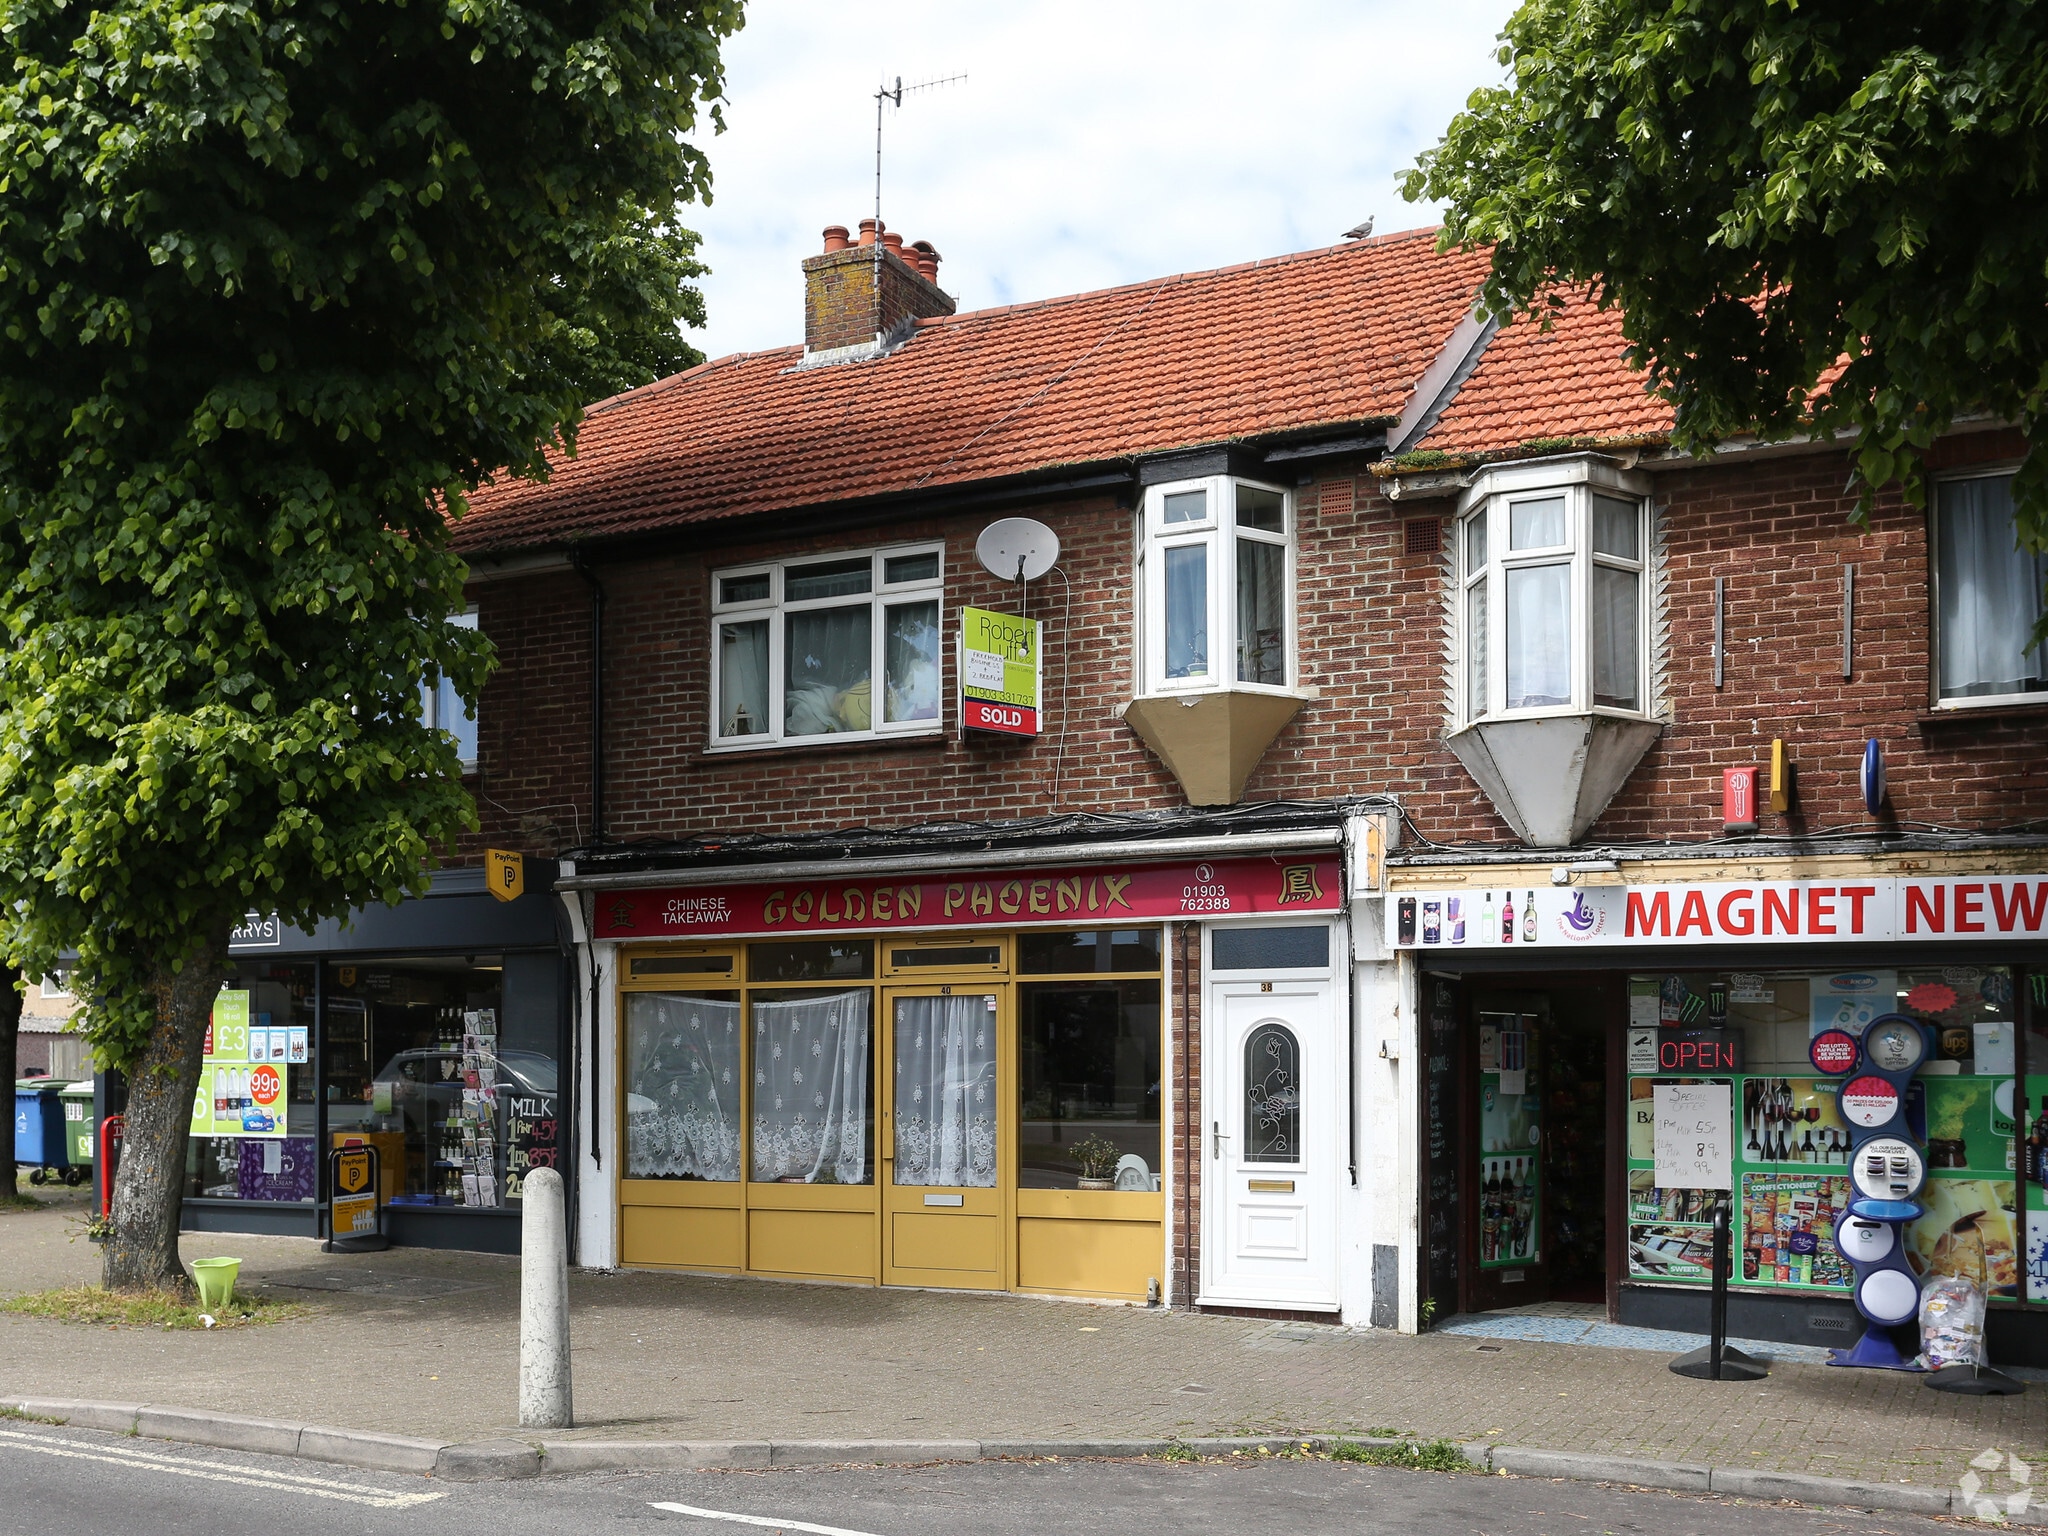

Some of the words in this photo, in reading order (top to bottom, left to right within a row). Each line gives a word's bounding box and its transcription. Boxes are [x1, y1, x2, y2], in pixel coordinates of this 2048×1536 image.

[980, 617, 1034, 646] Robert
[1000, 690, 1034, 706] 331737
[980, 705, 1022, 727] SOLD
[494, 852, 521, 863] PayPoint
[1183, 884, 1226, 898] 01903
[667, 897, 726, 911] CHINESE
[763, 884, 922, 926] GOLDEN
[943, 874, 1134, 918] PHOENIX
[1180, 898, 1230, 911] 762388
[609, 897, 636, 931] 金
[662, 910, 732, 925] TAKEAWAY
[1625, 886, 1875, 938] MAGNET
[1906, 882, 2048, 934] NEW
[1556, 917, 1565, 930] The
[1562, 929, 1592, 941] National
[1591, 906, 1606, 936] Lottery
[941, 986, 951, 994] 40
[1261, 983, 1273, 992] 38
[219, 1026, 246, 1051] £3
[1945, 1037, 1968, 1053] ups
[1660, 1041, 1734, 1067] OPEN
[251, 1073, 280, 1096] 99p
[1669, 1087, 1708, 1102] SPECIAL
[510, 1097, 553, 1117] MILK
[1672, 1102, 1706, 1112] OFFER
[507, 1116, 520, 1142] 1
[341, 1157, 367, 1167] PayPoint
[506, 1144, 520, 1172] 1
[1751, 1181, 1818, 1192] CONFECTIONERY
[1636, 1204, 1659, 1213] BEERS
[1670, 1265, 1701, 1273] SWEETS
